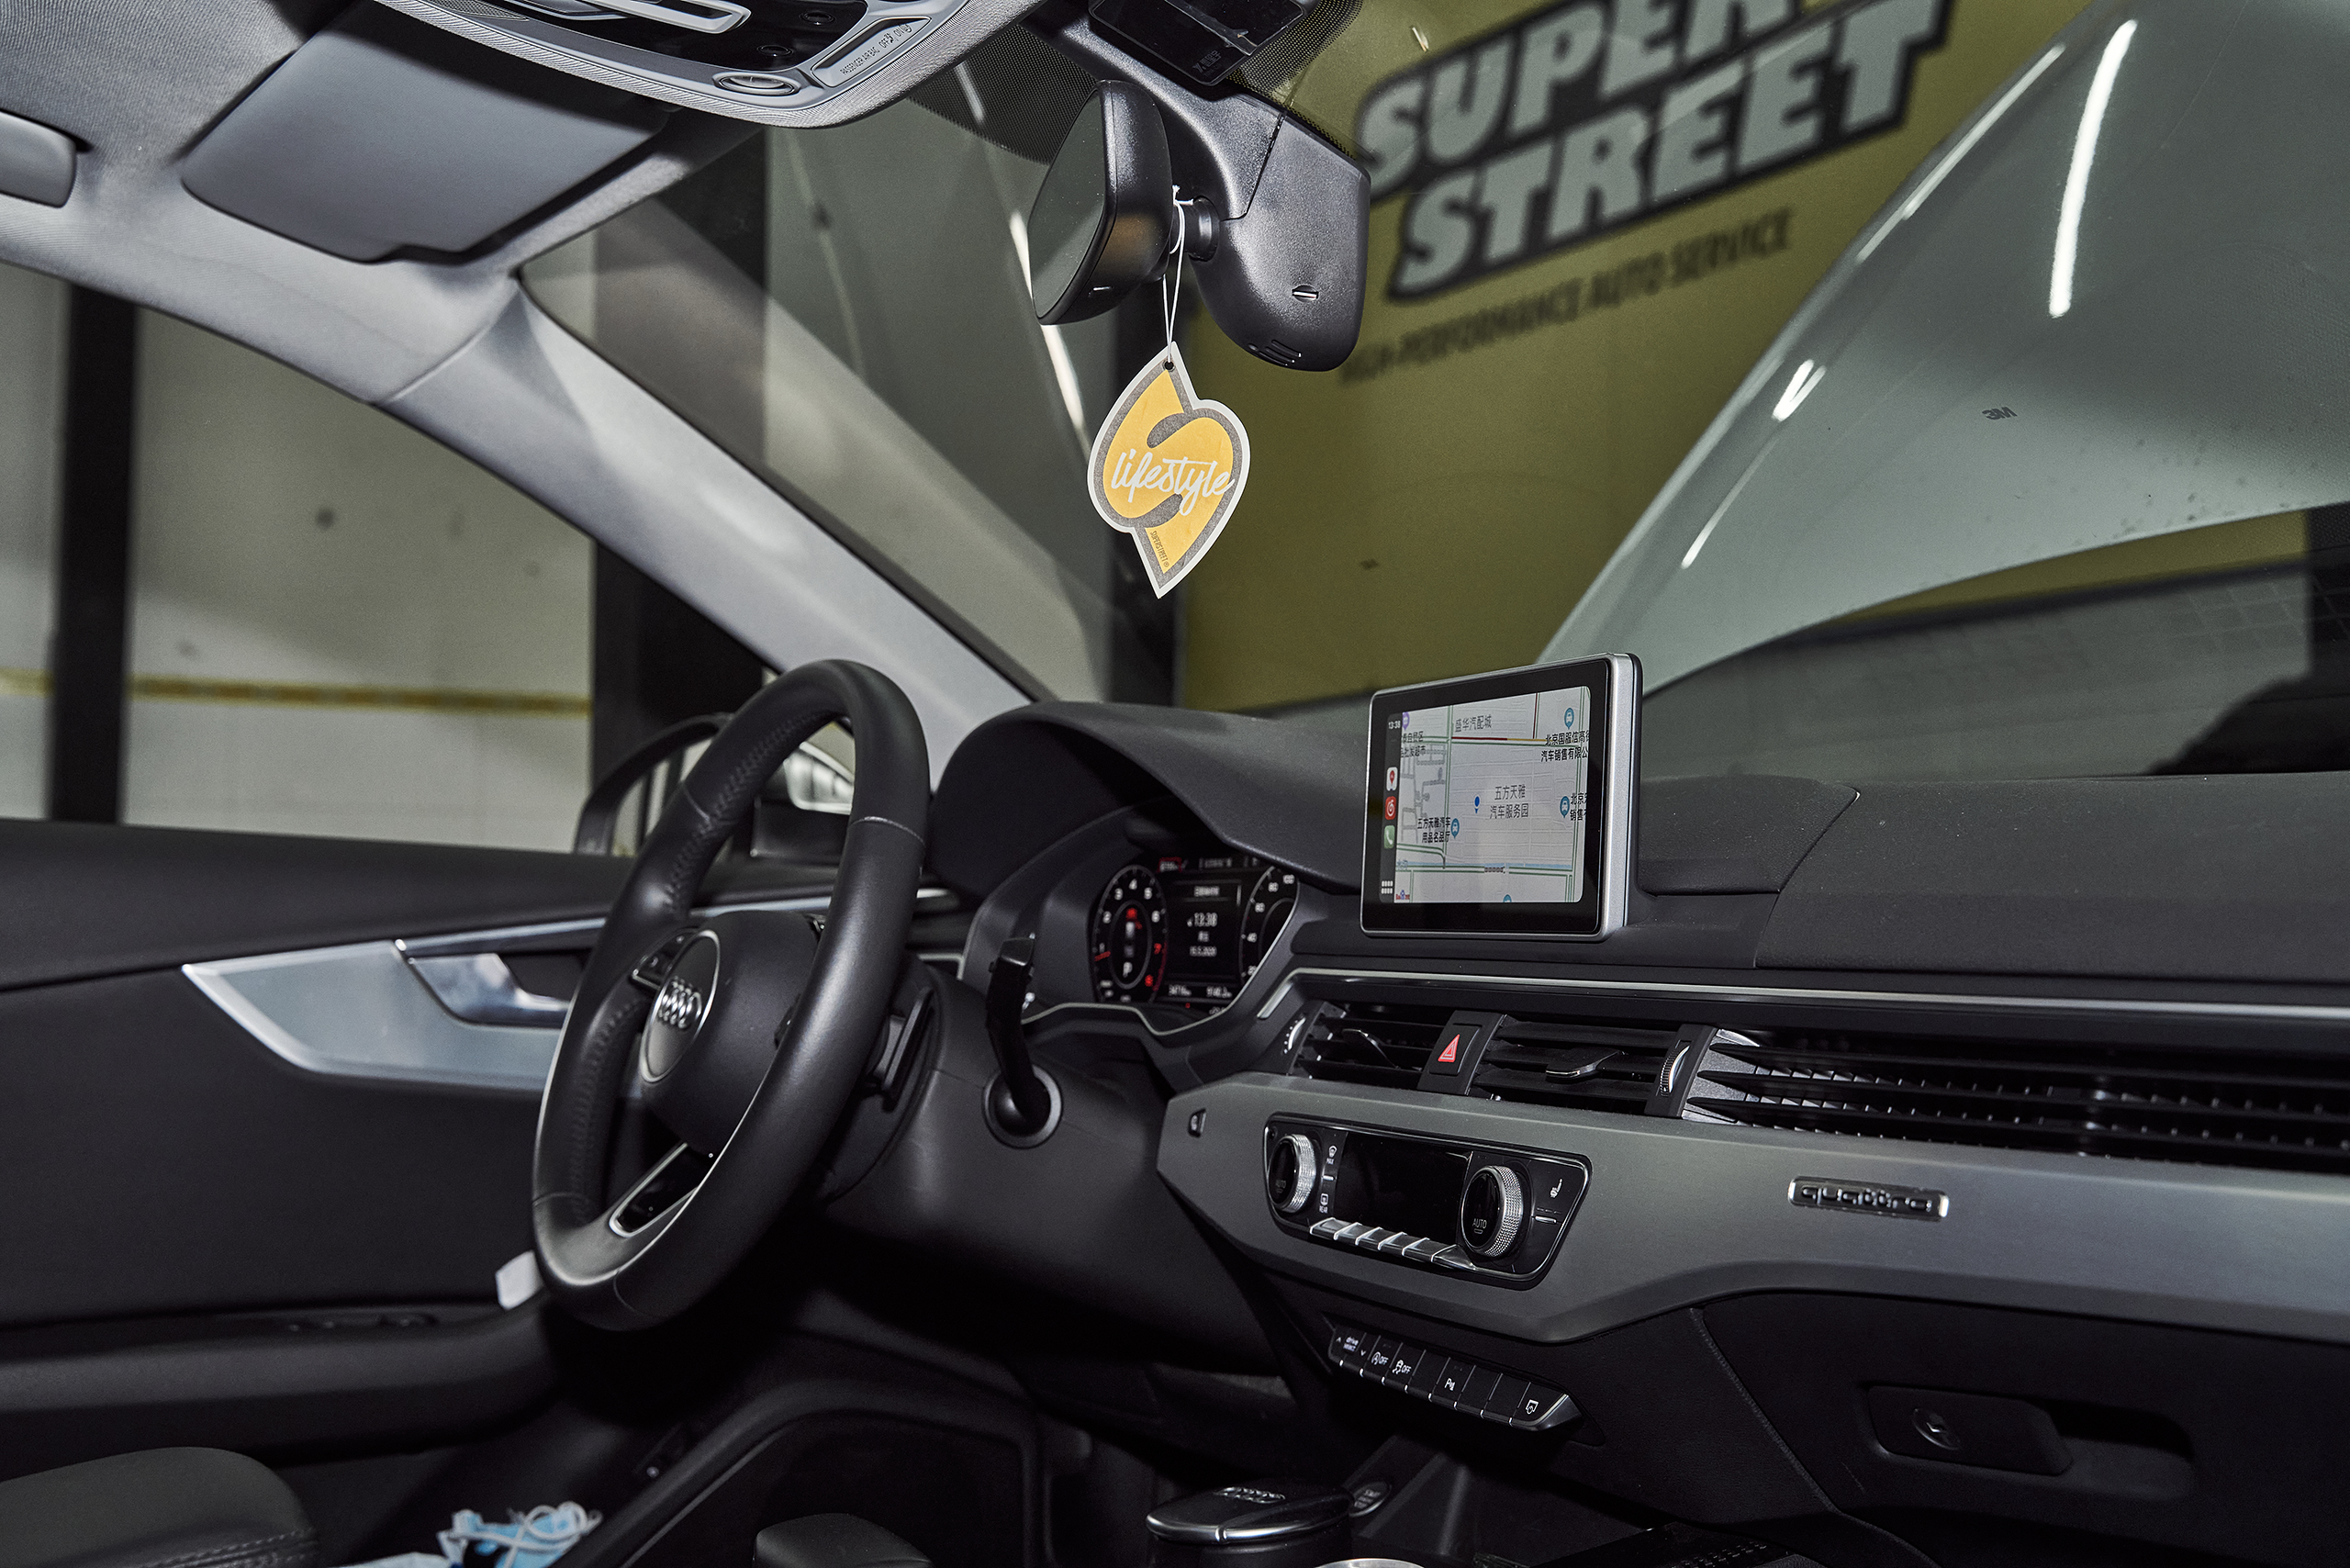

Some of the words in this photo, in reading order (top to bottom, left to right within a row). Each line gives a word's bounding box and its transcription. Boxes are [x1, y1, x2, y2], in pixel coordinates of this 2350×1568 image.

[1393, 0, 1941, 294] STREET
[1982, 406, 2018, 420] 3M
[1111, 448, 1236, 516] lifestyle
[1494, 784, 1526, 801] 五方天雅
[1489, 803, 1529, 820] 汽车服务园
[1802, 1186, 1932, 1213] quattro
[1472, 1217, 1488, 1229] AUTO
[1379, 1356, 1389, 1365] OFF
[1402, 1365, 1412, 1374] OFF
